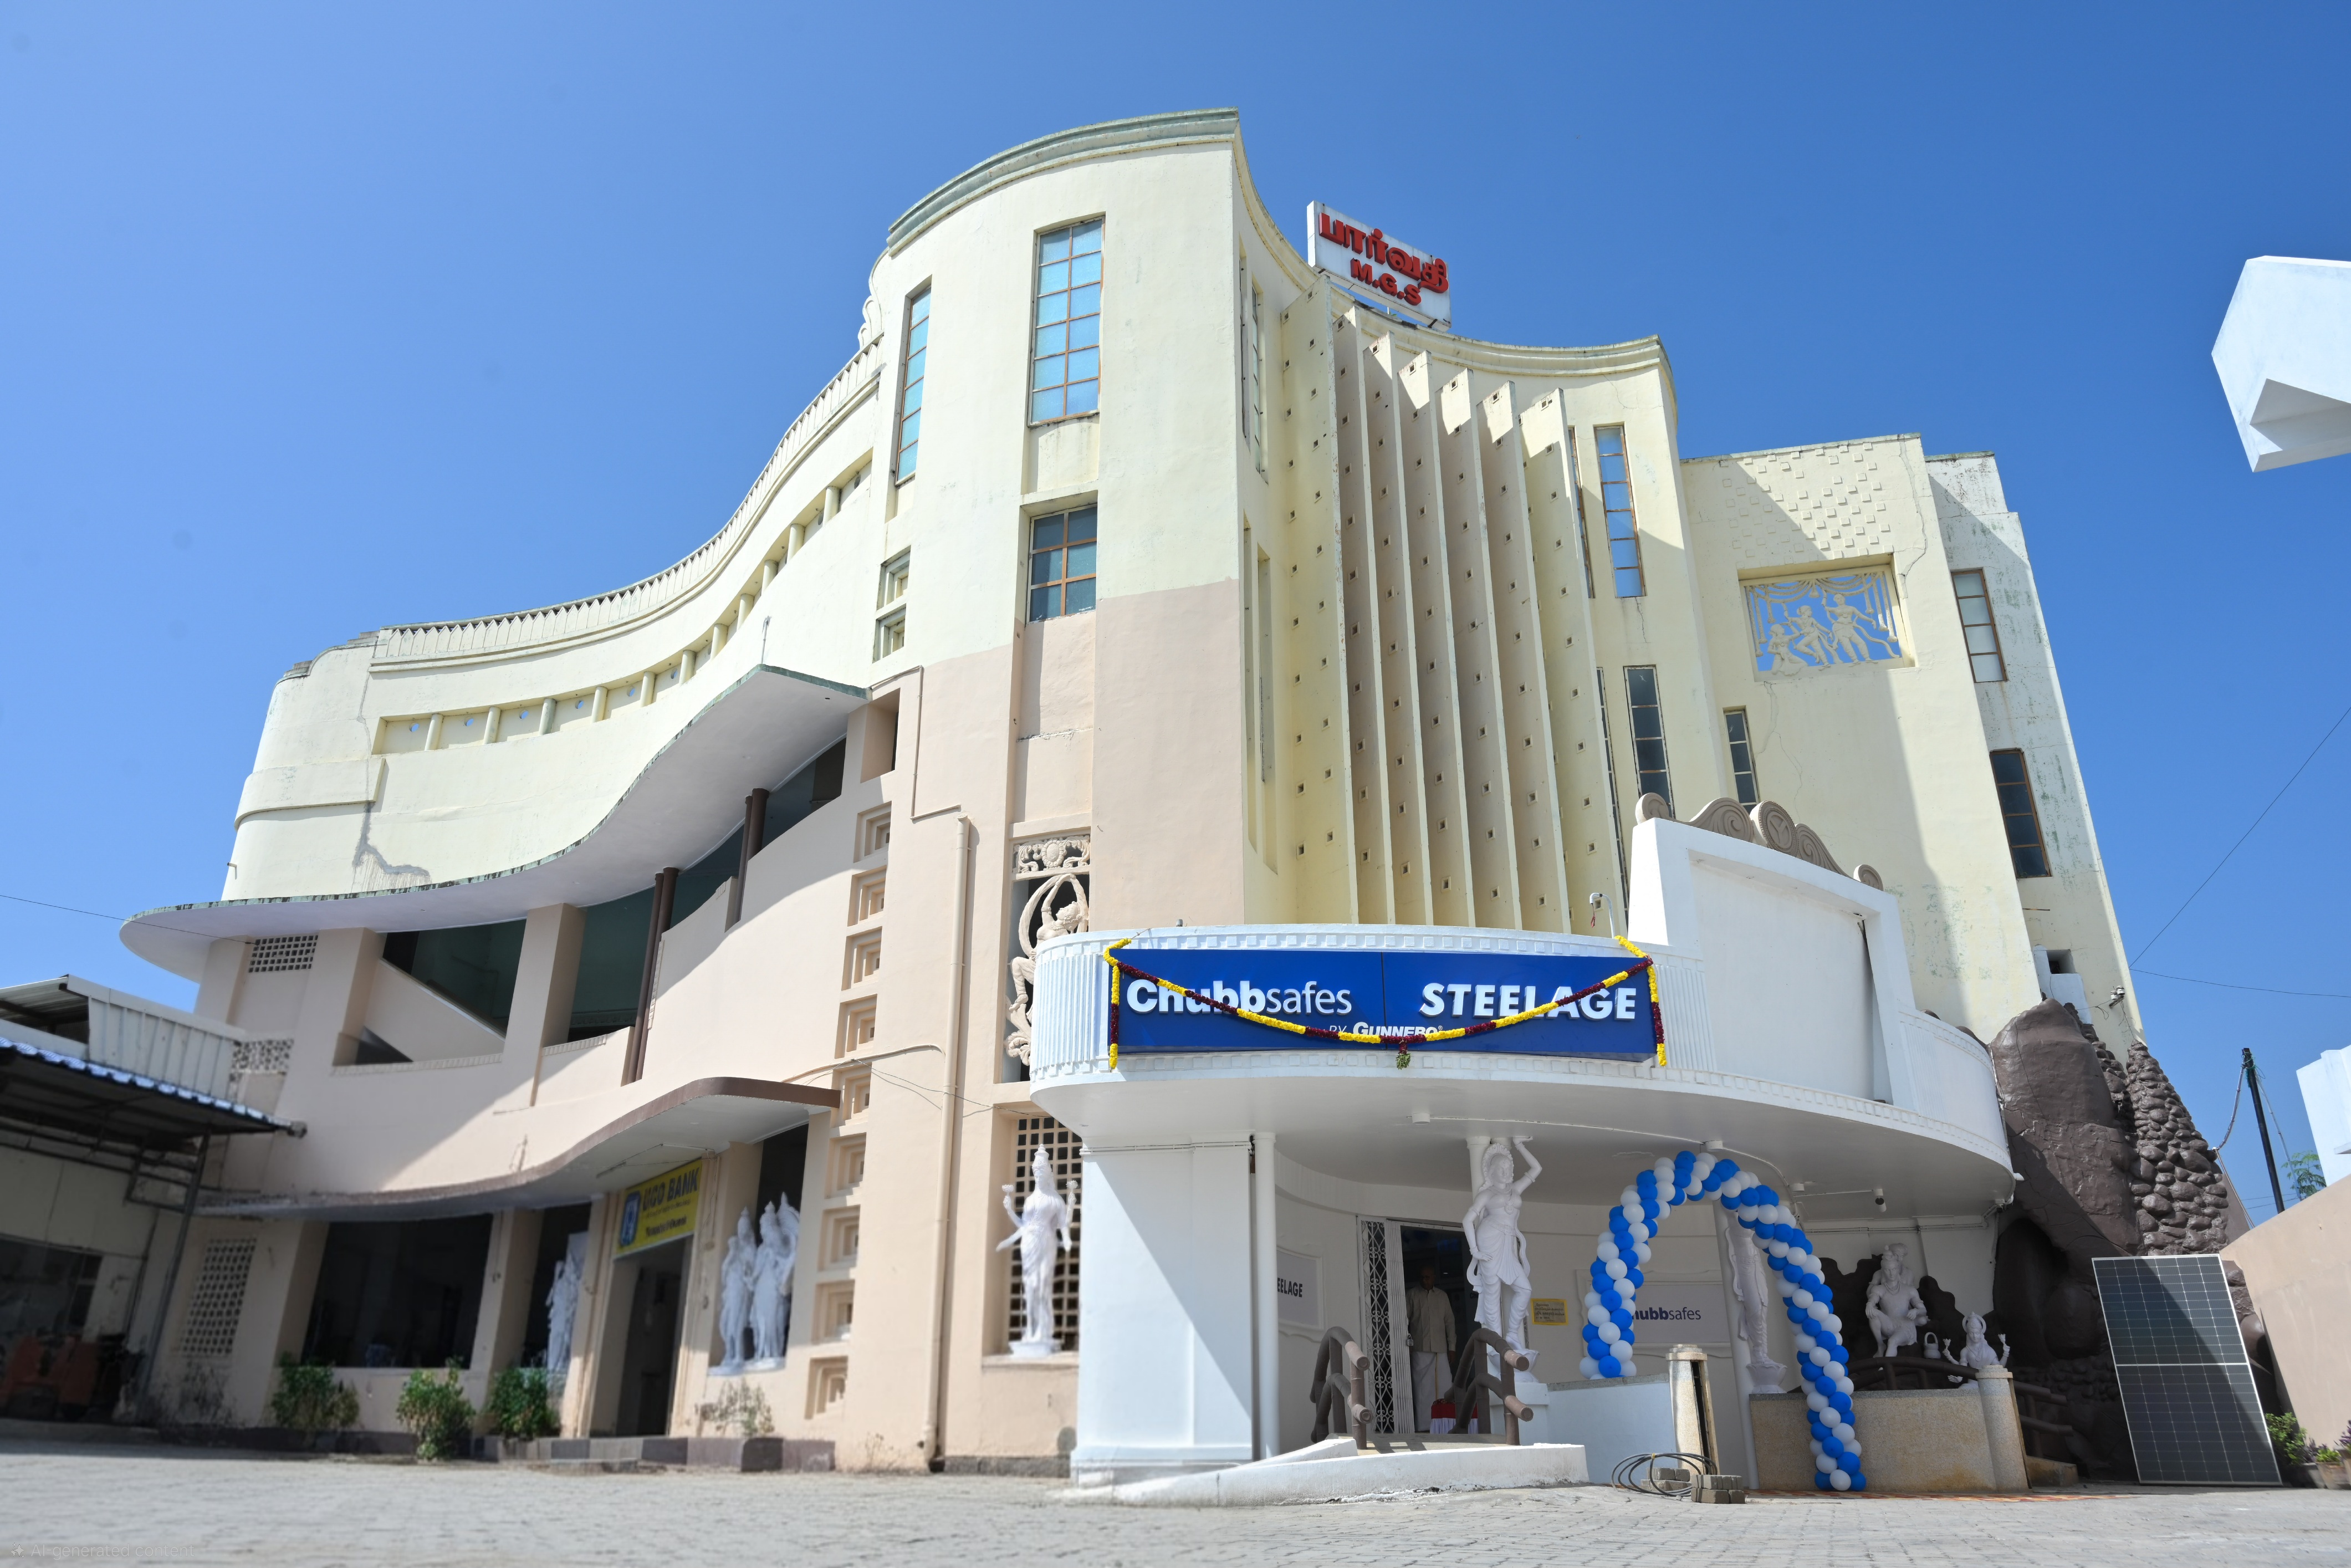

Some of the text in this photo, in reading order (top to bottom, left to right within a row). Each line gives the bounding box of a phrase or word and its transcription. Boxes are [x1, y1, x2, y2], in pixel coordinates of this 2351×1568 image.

[1318, 212, 1449, 294] பார்வதி
[1350, 257, 1422, 306] M.G.S
[1127, 979, 1637, 1020] Chubbsafes STEELAGE
[643, 1167, 700, 1211] UCO BANK
[1277, 1277, 1303, 1298] EELAGE
